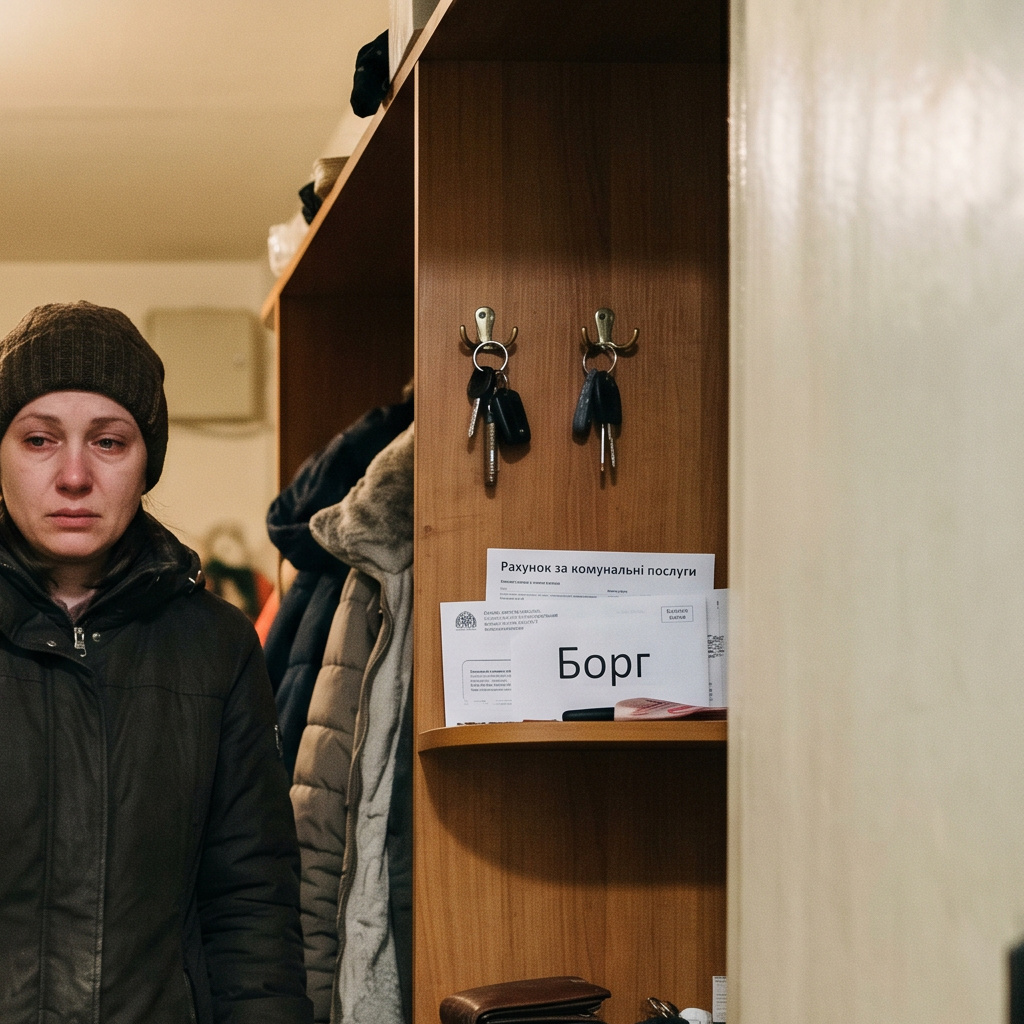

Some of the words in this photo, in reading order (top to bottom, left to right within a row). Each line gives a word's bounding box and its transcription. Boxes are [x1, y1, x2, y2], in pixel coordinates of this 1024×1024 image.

[501, 561, 551, 576] Рахунок
[555, 565, 568, 573] за
[571, 564, 644, 577] комунальні
[647, 567, 697, 579] послуги
[558, 646, 650, 687] Борг
